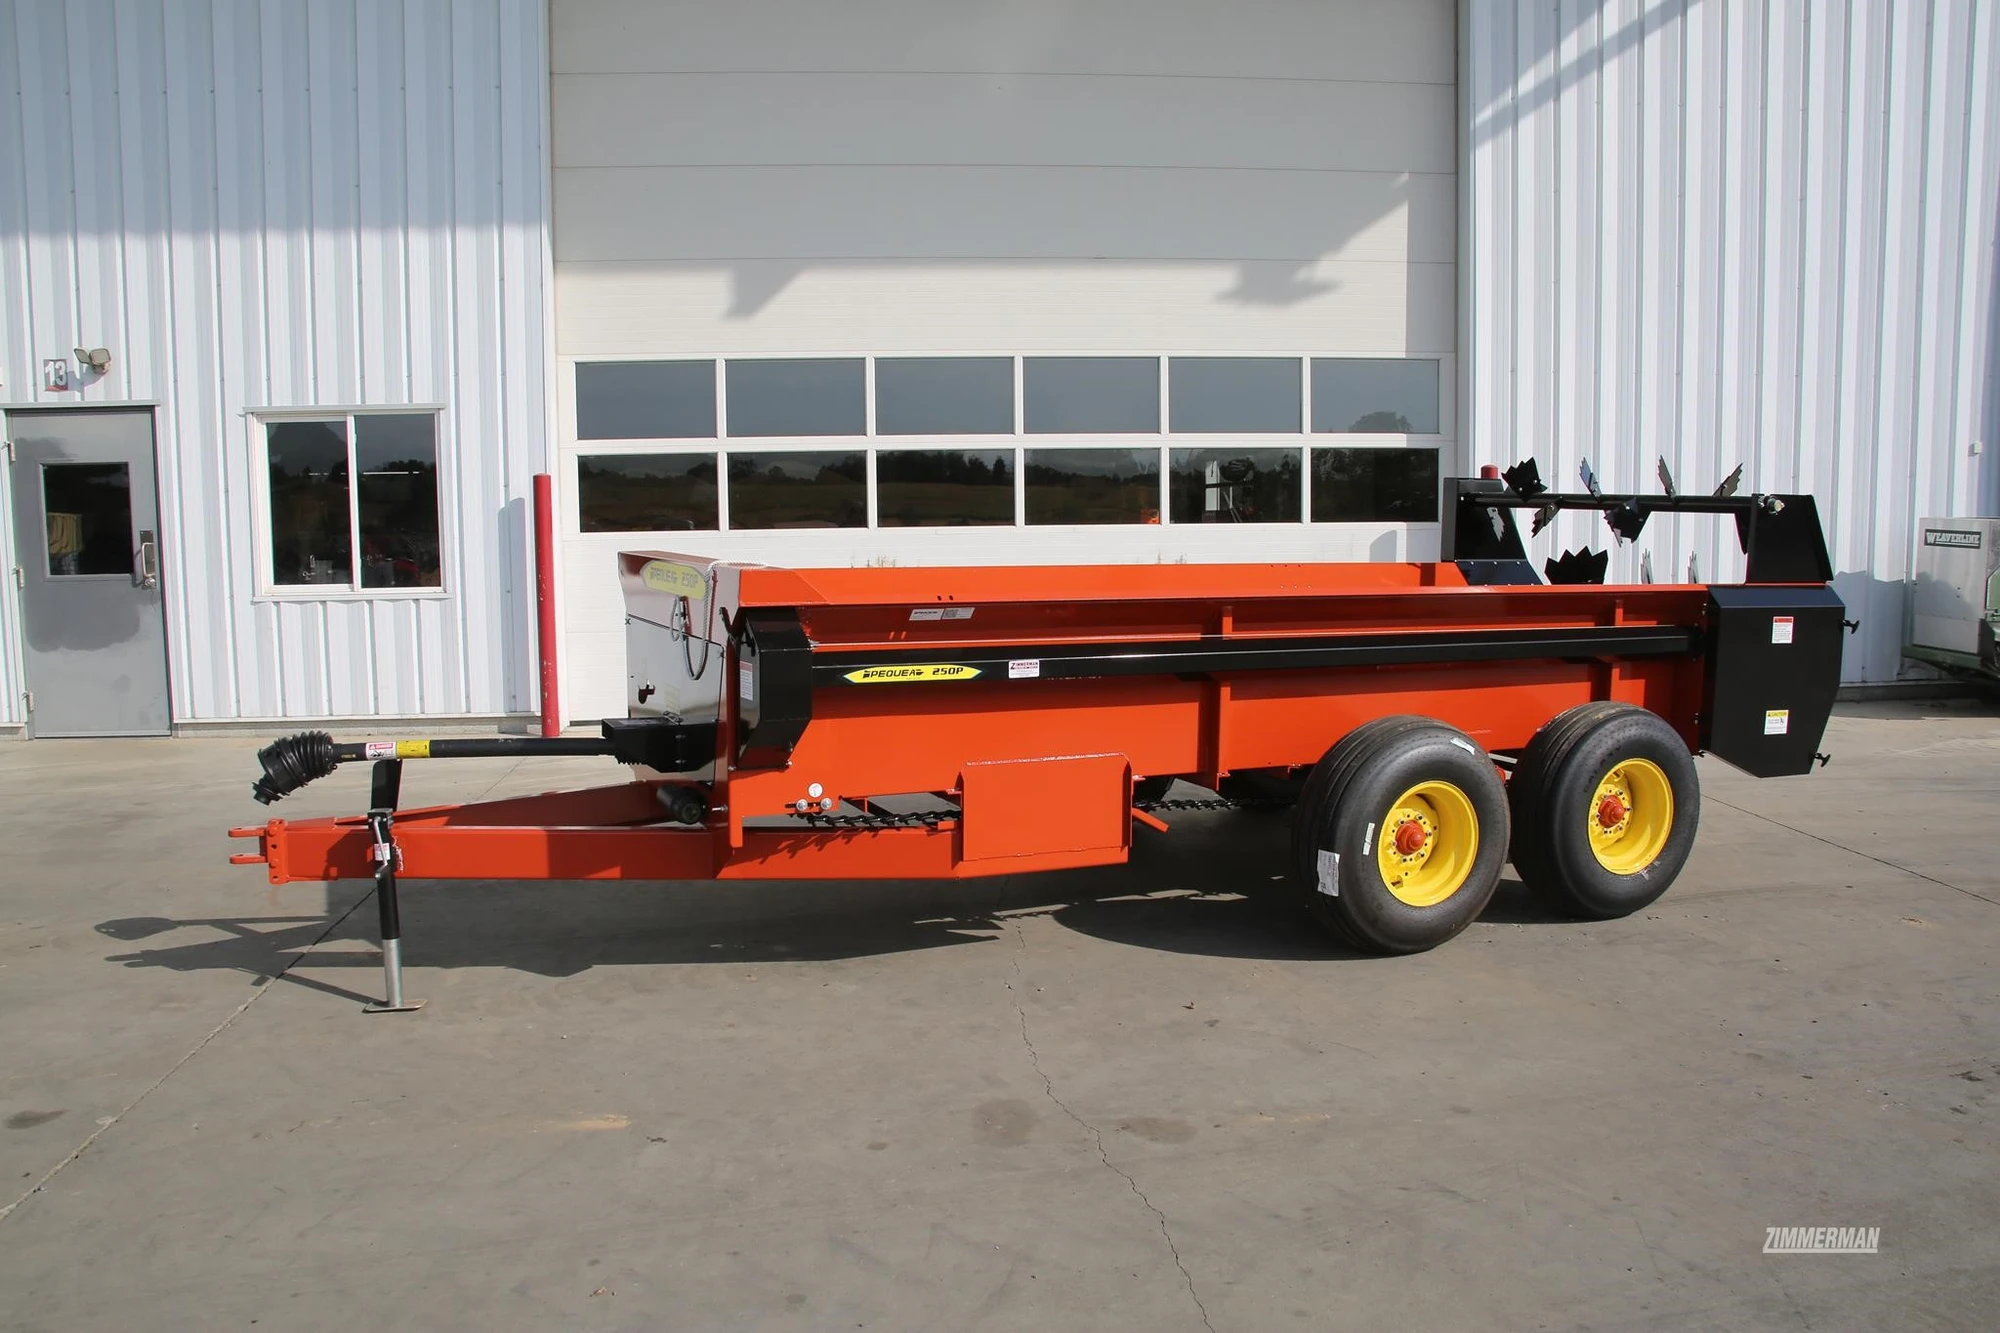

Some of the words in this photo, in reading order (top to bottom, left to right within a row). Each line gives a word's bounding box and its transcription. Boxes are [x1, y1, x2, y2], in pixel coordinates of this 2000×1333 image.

[45, 361, 67, 386] 13
[869, 669, 917, 678] PEQUEA
[932, 667, 964, 676] 250P
